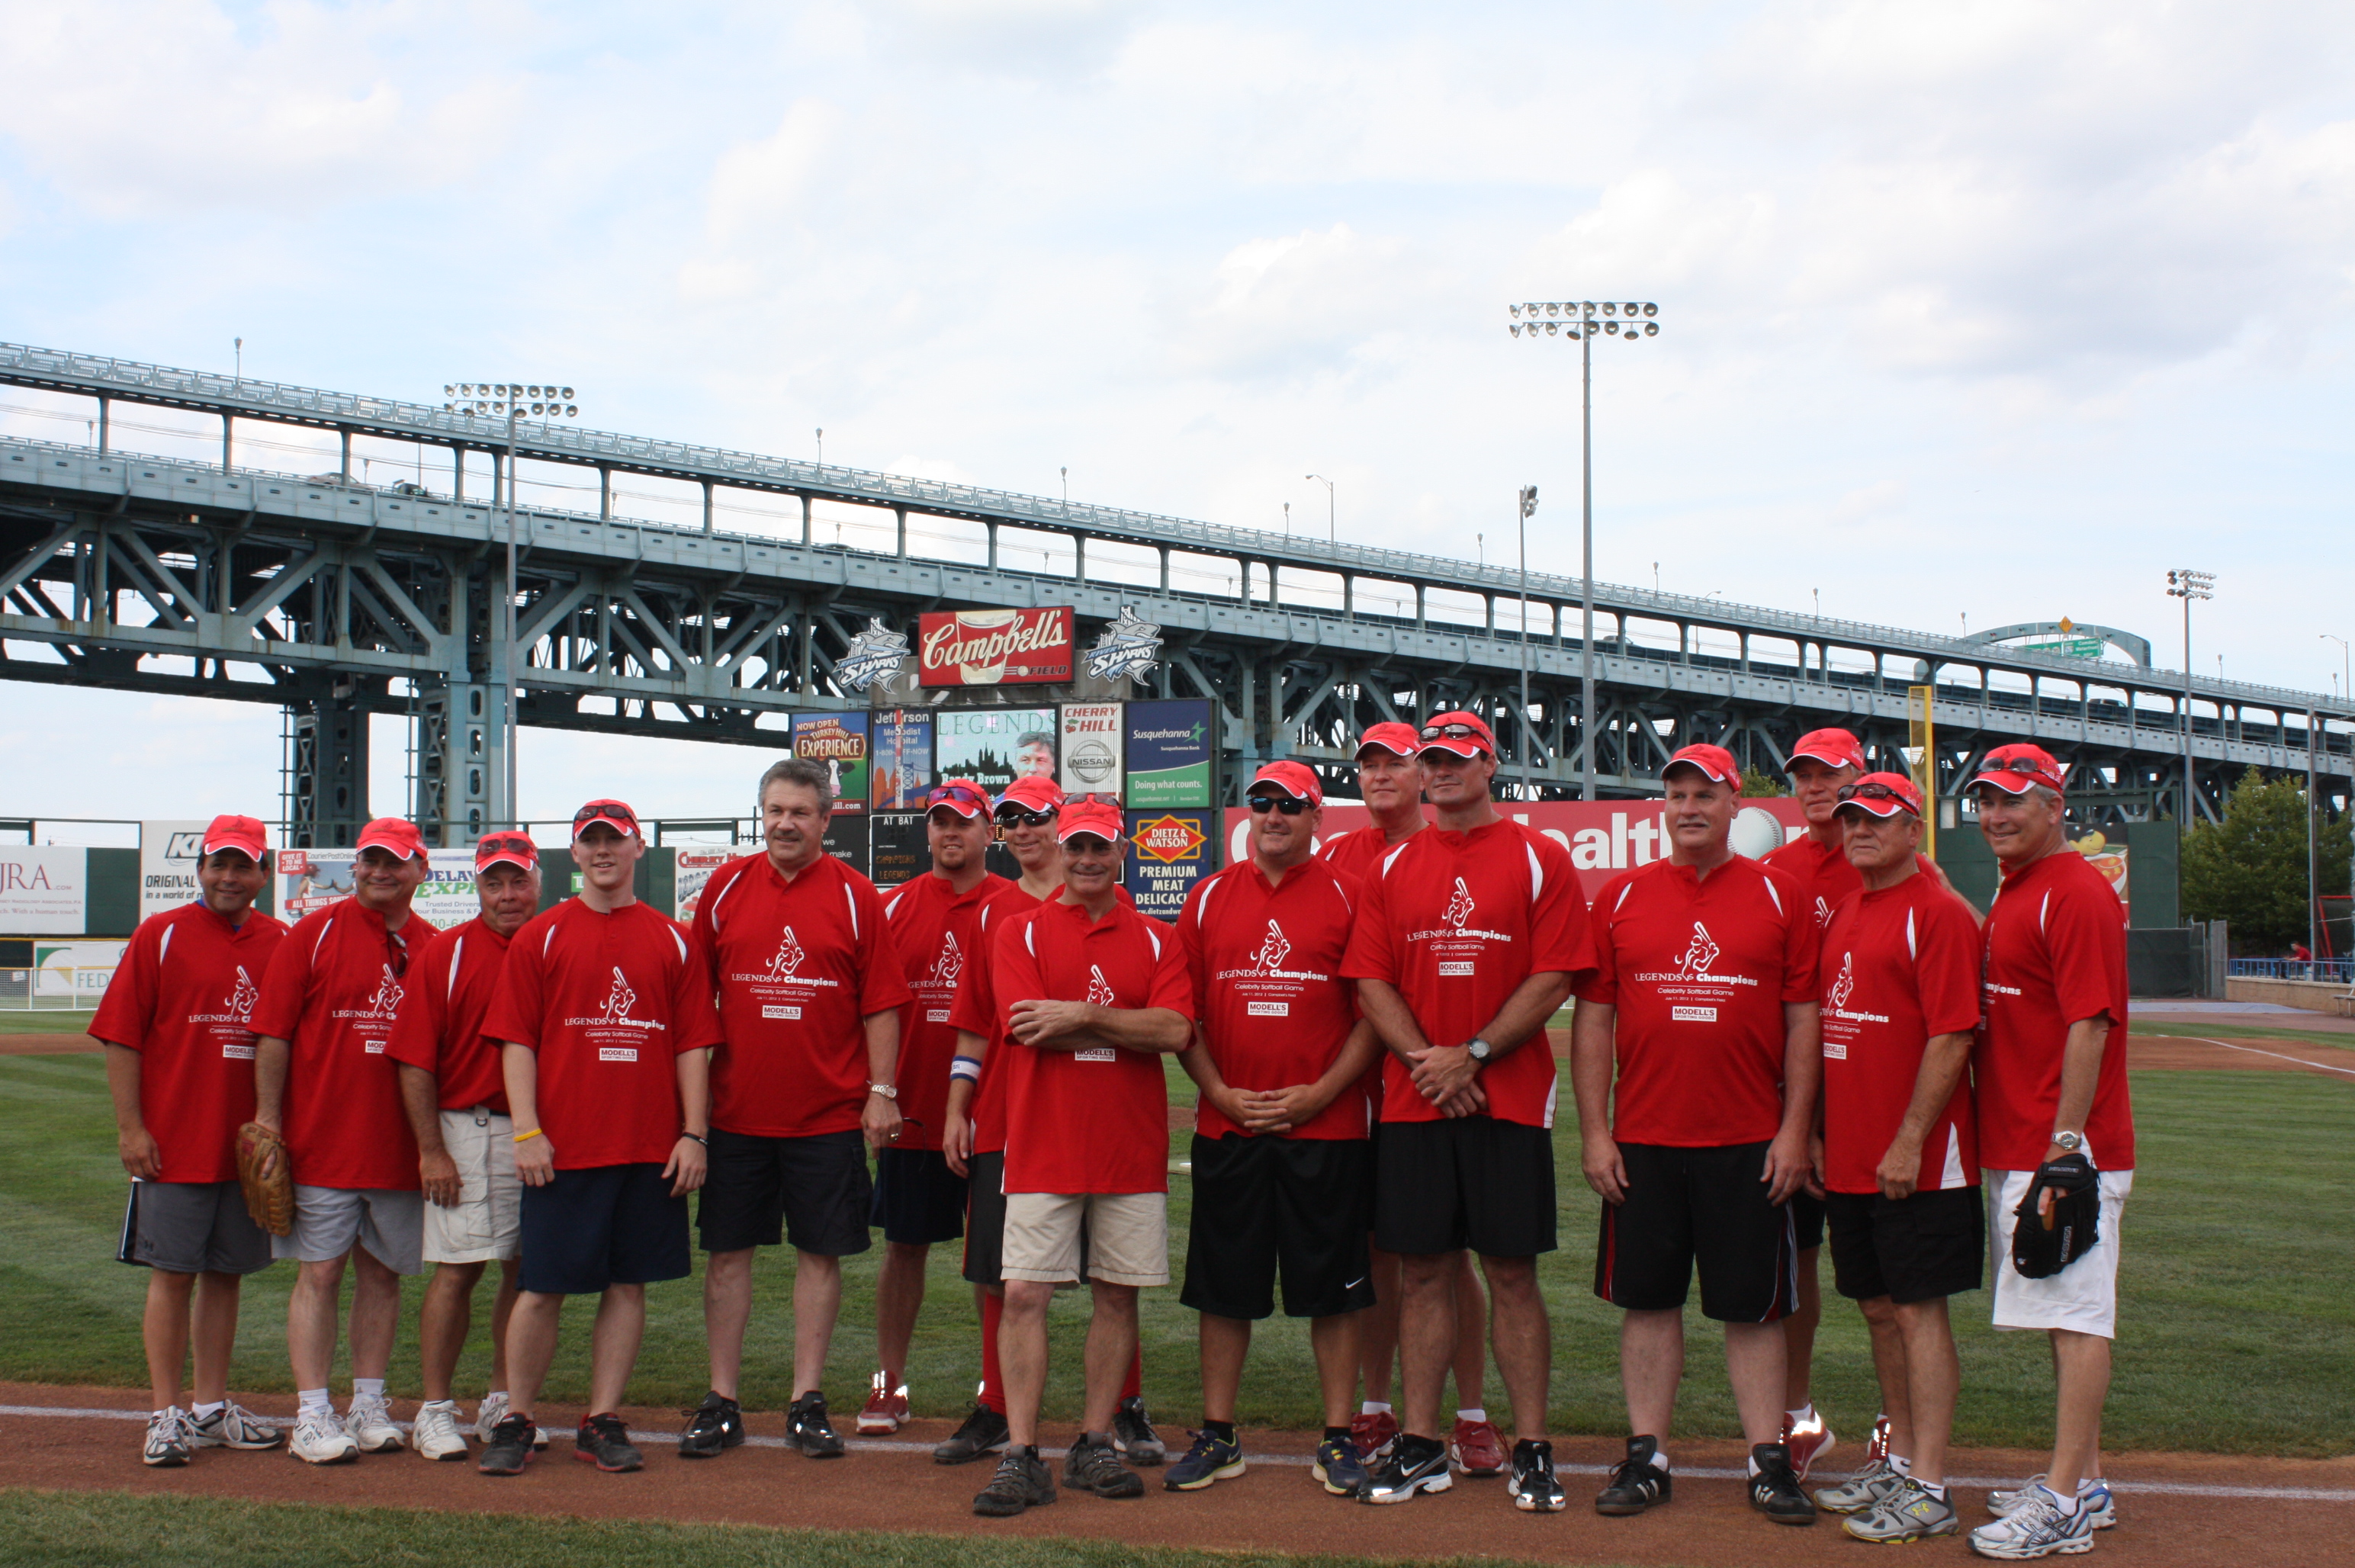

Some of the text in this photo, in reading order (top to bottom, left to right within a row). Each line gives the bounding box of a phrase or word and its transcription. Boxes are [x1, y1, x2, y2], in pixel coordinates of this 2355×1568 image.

[924, 609, 1068, 670] Campbell's
[1088, 647, 1117, 658] RIVER
[840, 656, 867, 668] RIVER
[1089, 646, 1152, 677] SHARKS
[840, 655, 901, 685] SHARKS
[1030, 665, 1068, 676] FIELD
[1065, 707, 1118, 717] CHERRY
[796, 718, 839, 731] NOW OPEN
[937, 712, 1055, 735] LEGENDS
[1079, 719, 1117, 732] HILL
[810, 728, 850, 741] TURKEY HILL
[1133, 728, 1190, 741] Susquehanna
[801, 738, 859, 757] EXPERIENCE
[977, 772, 1010, 784] Brown
[1135, 780, 1156, 791] Doing
[1157, 780, 1175, 789] what
[883, 817, 914, 825] AT BAT
[1152, 828, 1188, 838] DIETZ &
[998, 843, 1003, 852] 7
[1145, 837, 1188, 847] WATSON
[1139, 866, 1197, 877] PREMIUM
[146, 875, 196, 888] ORIGINAL
[1152, 879, 1184, 891] MEAT
[292, 898, 328, 908] ALL THINGS
[732, 973, 838, 987] LEGENDS Champions
[1216, 969, 1328, 982] LEGENDS Champions
[1634, 972, 1682, 982] LEGENDS
[1696, 973, 1758, 986] Champions
[188, 1014, 232, 1023] LEGENDS
[333, 1010, 375, 1018] LEGENDS
[1836, 1008, 1889, 1023] Champions
[565, 1017, 607, 1026] LEGENDS
[2061, 1226, 2072, 1262] EASTON
